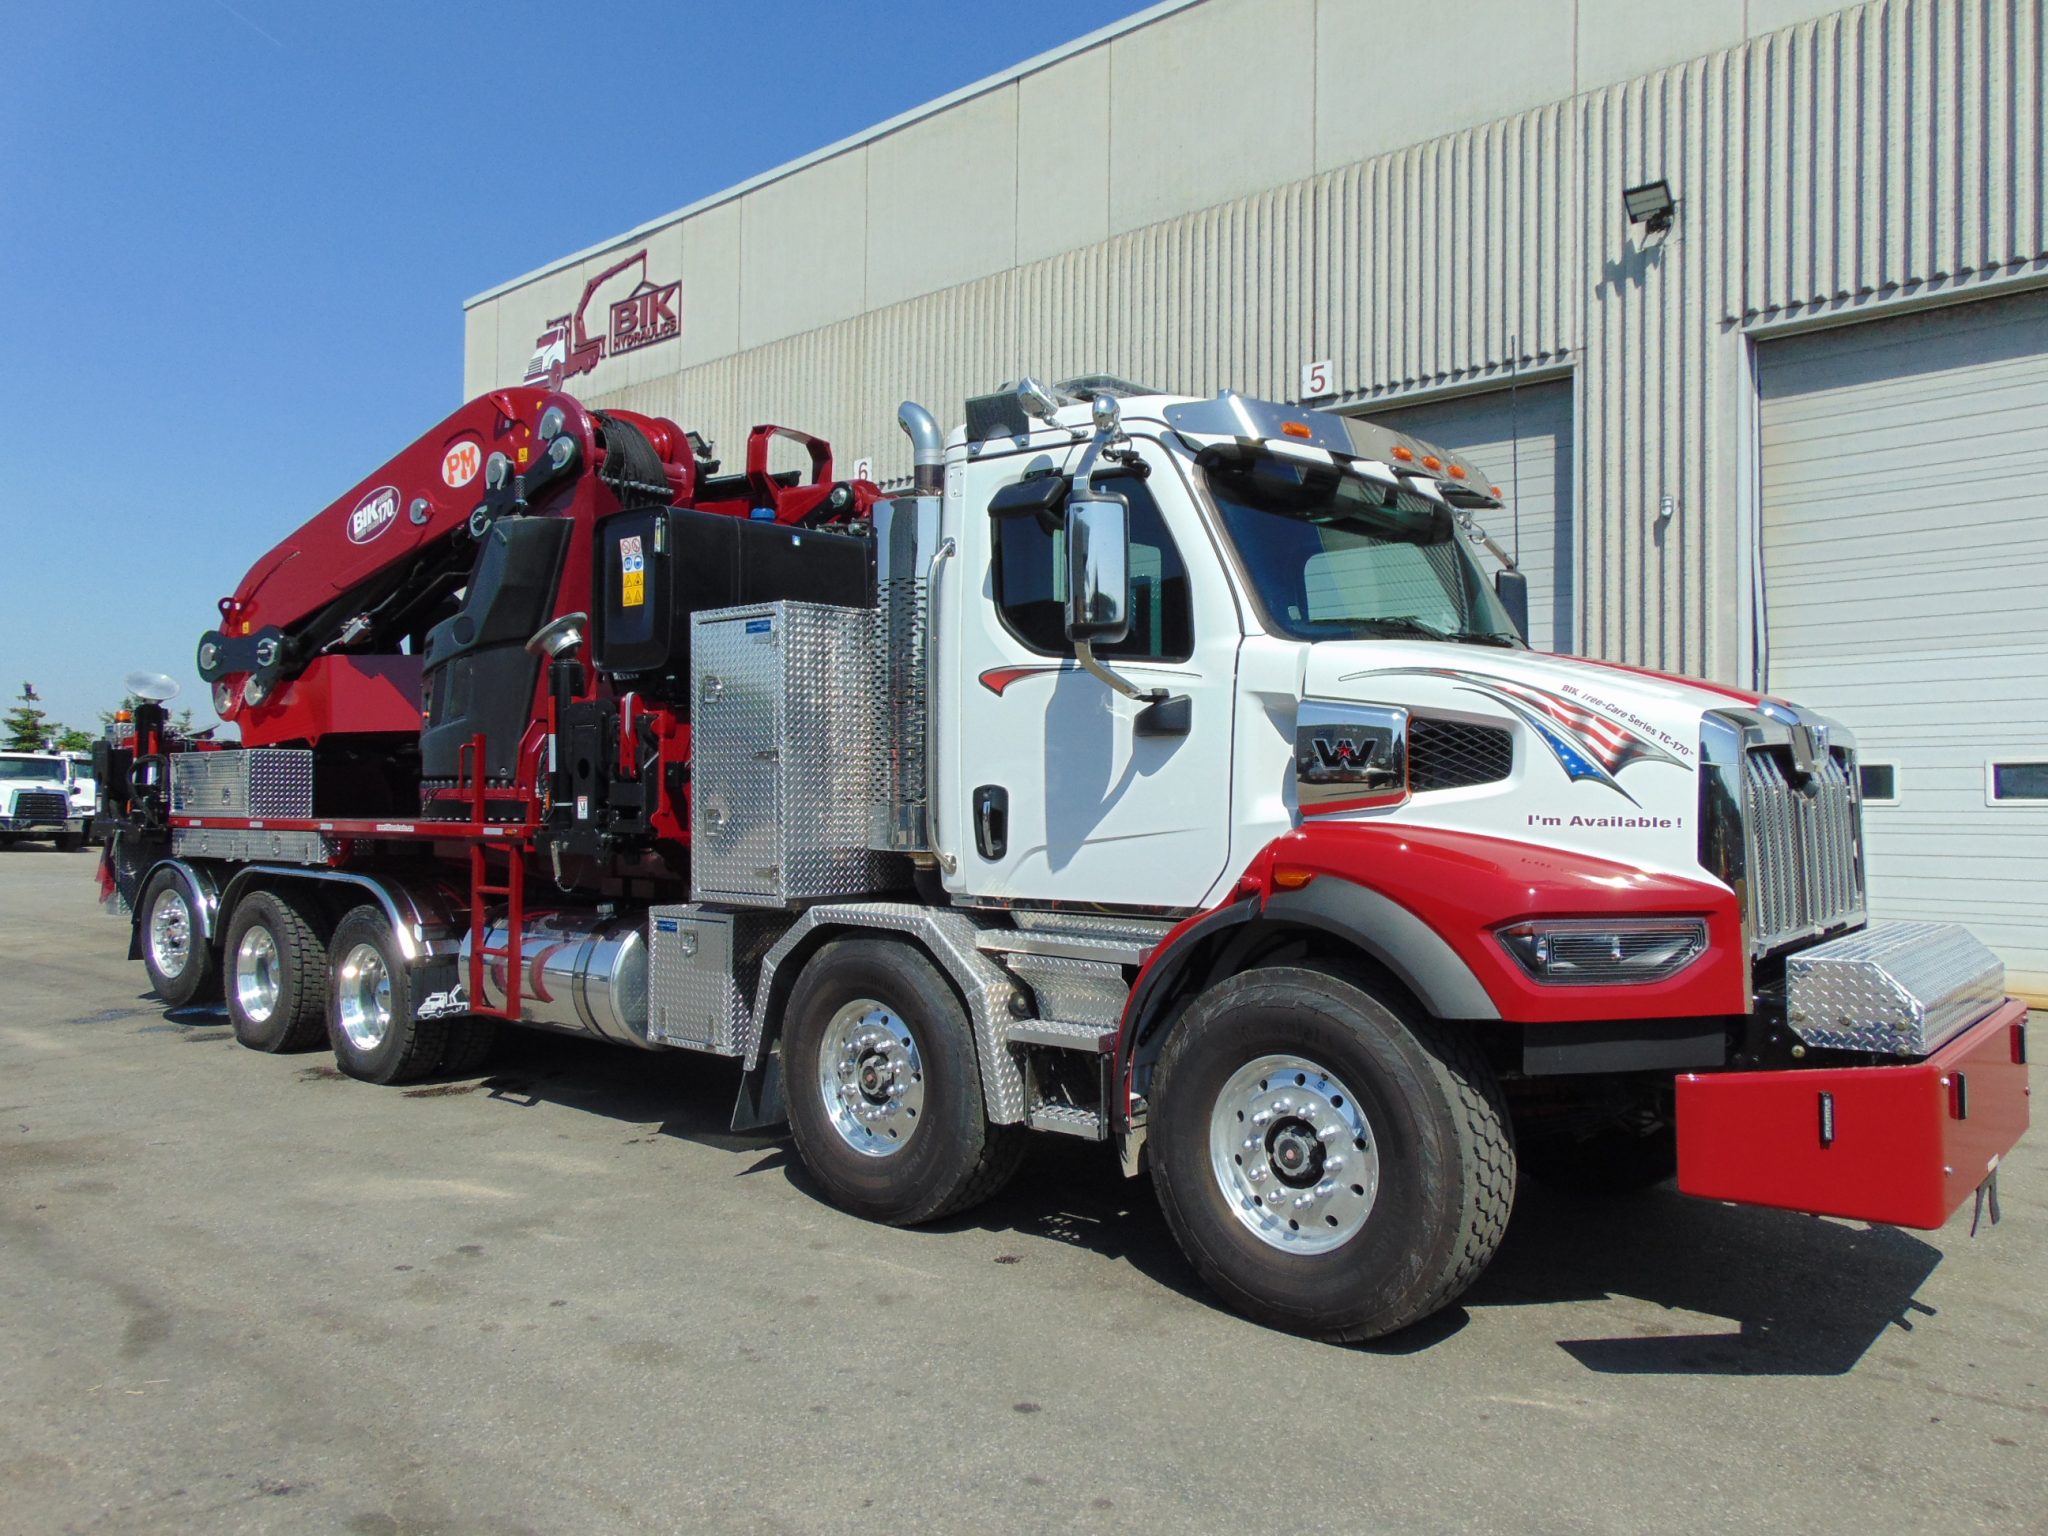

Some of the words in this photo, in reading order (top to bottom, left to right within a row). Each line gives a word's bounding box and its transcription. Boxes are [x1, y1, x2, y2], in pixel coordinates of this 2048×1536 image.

[614, 287, 677, 337] BIK
[613, 320, 678, 351] HYDRAULICS
[1310, 364, 1326, 393] 5
[446, 446, 476, 486] PM
[858, 461, 868, 480] 6
[353, 499, 379, 535] BIK
[377, 498, 394, 524] 170
[1561, 684, 1580, 696] BIK
[1628, 714, 1657, 736] Series
[1527, 815, 1561, 826] I'm
